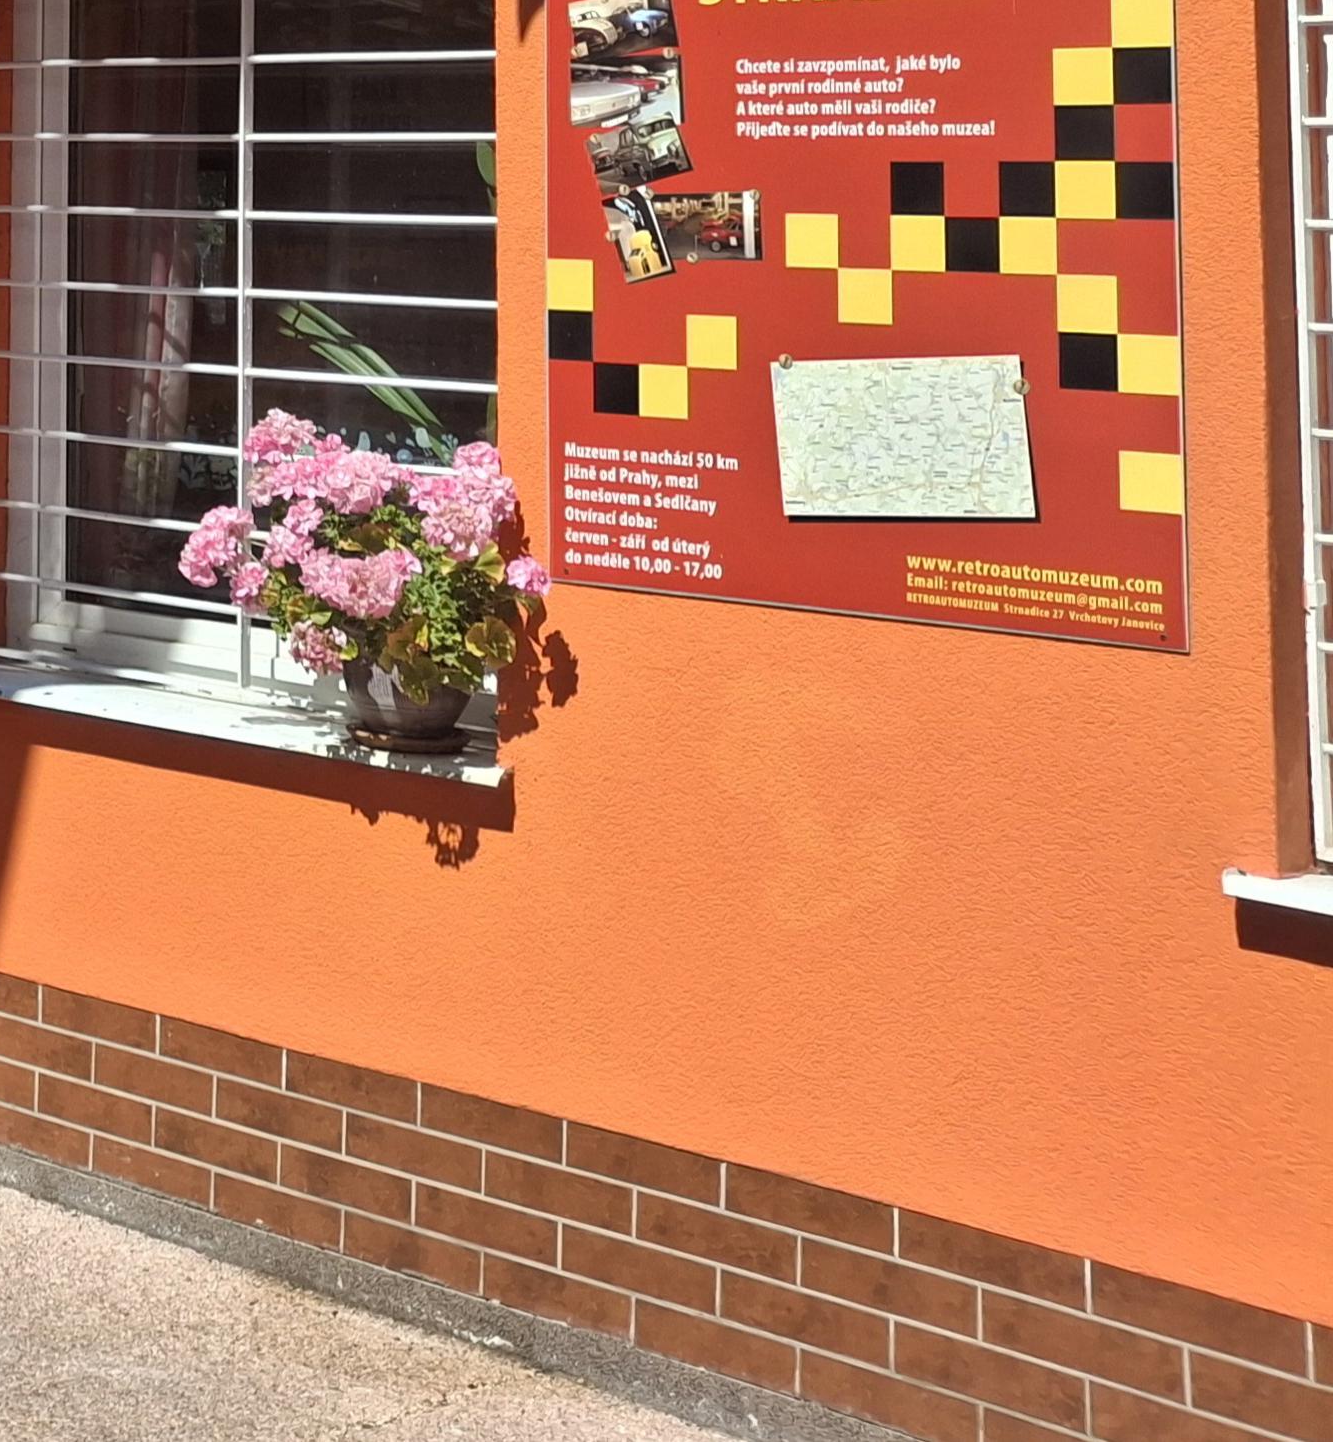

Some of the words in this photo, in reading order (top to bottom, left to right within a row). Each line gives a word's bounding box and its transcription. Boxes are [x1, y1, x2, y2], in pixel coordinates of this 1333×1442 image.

[736, 59, 780, 74] Chcete
[784, 59, 795, 73] si
[797, 56, 889, 75] zavzpomínat,
[895, 55, 926, 74] jaké
[929, 54, 961, 73] bylo
[736, 80, 766, 95] vaše
[768, 79, 805, 97] první
[808, 78, 861, 94] rodinné
[864, 77, 904, 93] auto?
[736, 101, 746, 116] A
[748, 99, 784, 115] které
[786, 101, 818, 115] auto
[821, 98, 852, 115] měli
[855, 98, 882, 114] vaši
[885, 97, 937, 114] rodiče?
[736, 121, 790, 139] Přijeďte
[793, 124, 808, 136] se
[811, 121, 864, 139] podívat
[867, 121, 884, 136] do
[887, 120, 938, 136] našeho
[942, 120, 995, 136] muzea!
[564, 442, 620, 461] Muzeum
[623, 450, 638, 462] se
[640, 449, 693, 467] nachází
[696, 452, 713, 469] 50
[716, 454, 739, 470] km
[564, 463, 596, 481] jižně
[599, 467, 616, 482] od
[619, 468, 662, 489] Prahy,
[665, 473, 699, 489] mezi
[564, 484, 640, 507] Benešovem
[643, 495, 652, 507] a
[654, 493, 717, 517] Sedlčany
[564, 506, 616, 525] Otvírací
[619, 512, 658, 529] doba:
[565, 527, 609, 546] červen
[619, 534, 646, 550] září
[652, 536, 670, 552] od
[672, 539, 710, 559] úterý
[565, 548, 582, 564] do
[584, 552, 630, 570] neděle
[634, 556, 672, 575] 10,00
[683, 561, 723, 580] 17,00
[906, 555, 1163, 595] www.retroautomuzeum.com
[906, 573, 949, 591] Email:
[951, 580, 1163, 615] retroautomuzeum@gmail.com
[906, 592, 999, 613] RETROAUTOMUZEUM
[1003, 603, 1050, 619] Strnadice
[1052, 610, 1064, 620] 27
[1068, 610, 1119, 628] Vrchotovy
[1121, 616, 1165, 632] Janovice
